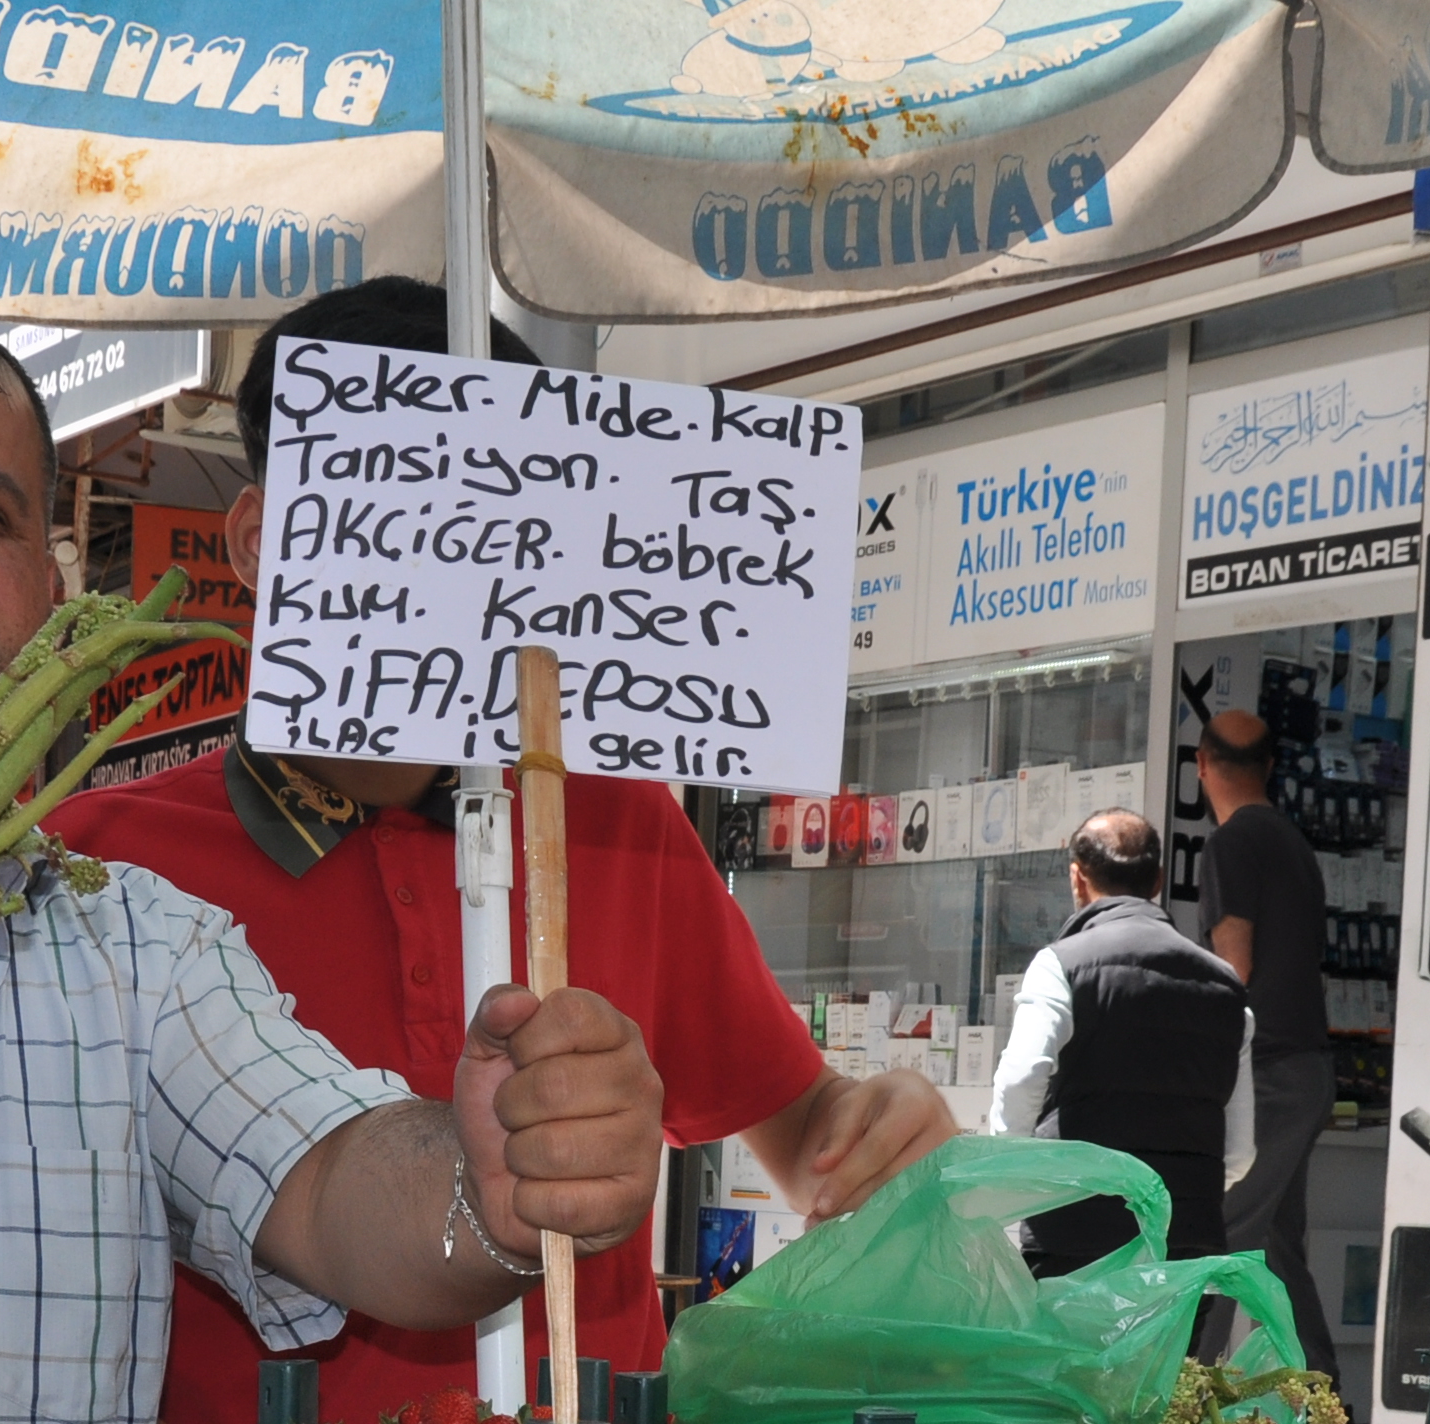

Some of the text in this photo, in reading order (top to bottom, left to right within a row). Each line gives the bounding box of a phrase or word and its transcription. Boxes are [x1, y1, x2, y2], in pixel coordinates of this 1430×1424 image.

[59, 358, 84, 393] 672
[87, 349, 104, 382] 72
[106, 339, 126, 372] 02
[1032, 511, 1126, 564] Telefon
[949, 574, 1148, 627] Aksesuar Markası
[1190, 555, 1291, 595] BOTAN
